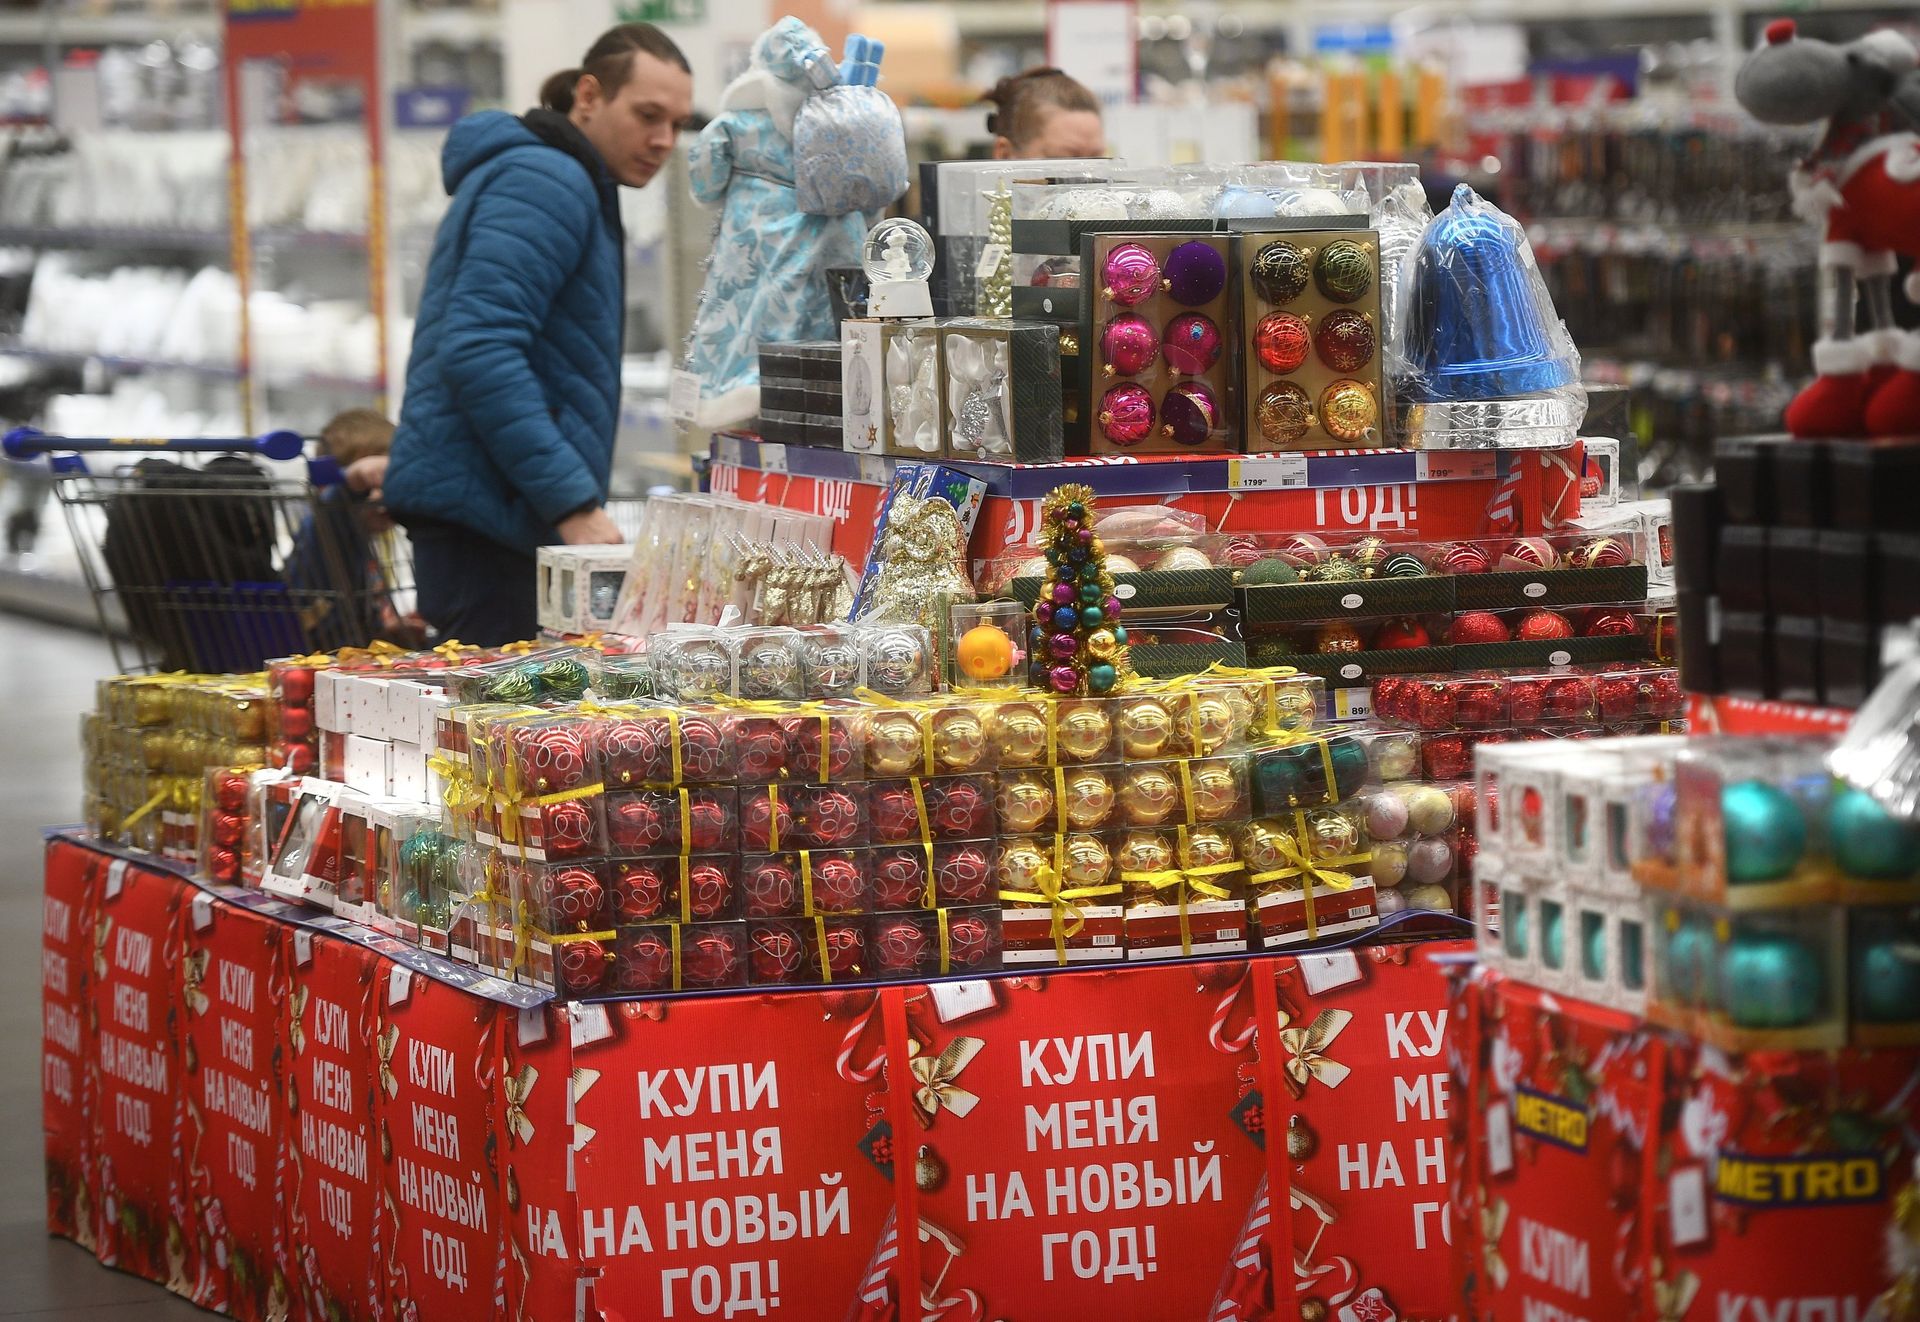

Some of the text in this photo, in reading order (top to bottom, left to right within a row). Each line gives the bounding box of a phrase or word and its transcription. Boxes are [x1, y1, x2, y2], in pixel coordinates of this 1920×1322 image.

[815, 478, 852, 525] ГОД!
[1315, 483, 1417, 531] ГОД!
[1352, 706, 1370, 715] 899
[44, 896, 70, 943] УПИ
[115, 926, 152, 978] КУПИ
[114, 982, 148, 1033] МЕНЯ
[219, 959, 255, 1013] КУПИ
[220, 1017, 253, 1071] МЕНЯ
[314, 997, 349, 1054] КУПИ
[1385, 1010, 1448, 1058] КУ
[101, 1030, 168, 1095] НА НОВЫЙ
[313, 1056, 352, 1114] МЕНЯ
[408, 1038, 456, 1098] КУПИ
[1019, 1031, 1155, 1087] КУПИ
[204, 1067, 271, 1136] НА НОВЫЙ
[638, 1061, 779, 1119] КУПИ
[1394, 1073, 1450, 1122] МЕ
[302, 1110, 367, 1184] НА НОВЫЙ
[412, 1101, 460, 1162] МЕНЯ
[1025, 1095, 1158, 1152] МЕНЯ
[1517, 1093, 1587, 1147] METRO
[228, 1133, 256, 1191] ГОД!
[643, 1127, 783, 1185] МЕНЯ
[966, 1140, 1222, 1221] НА НОВЫЙ
[1338, 1141, 1405, 1190] НА
[1717, 1157, 1880, 1201] METRO
[319, 1178, 352, 1240] ГОД!
[398, 1156, 487, 1234] НА НОВЫЙ
[583, 1172, 850, 1258] НА НОВЫЙ
[527, 1204, 569, 1259] НА
[1042, 1225, 1157, 1283] ГОД!
[1519, 1217, 1590, 1299] КУПИ
[422, 1228, 468, 1294] ГОД!
[661, 1259, 780, 1319] ГОД!
